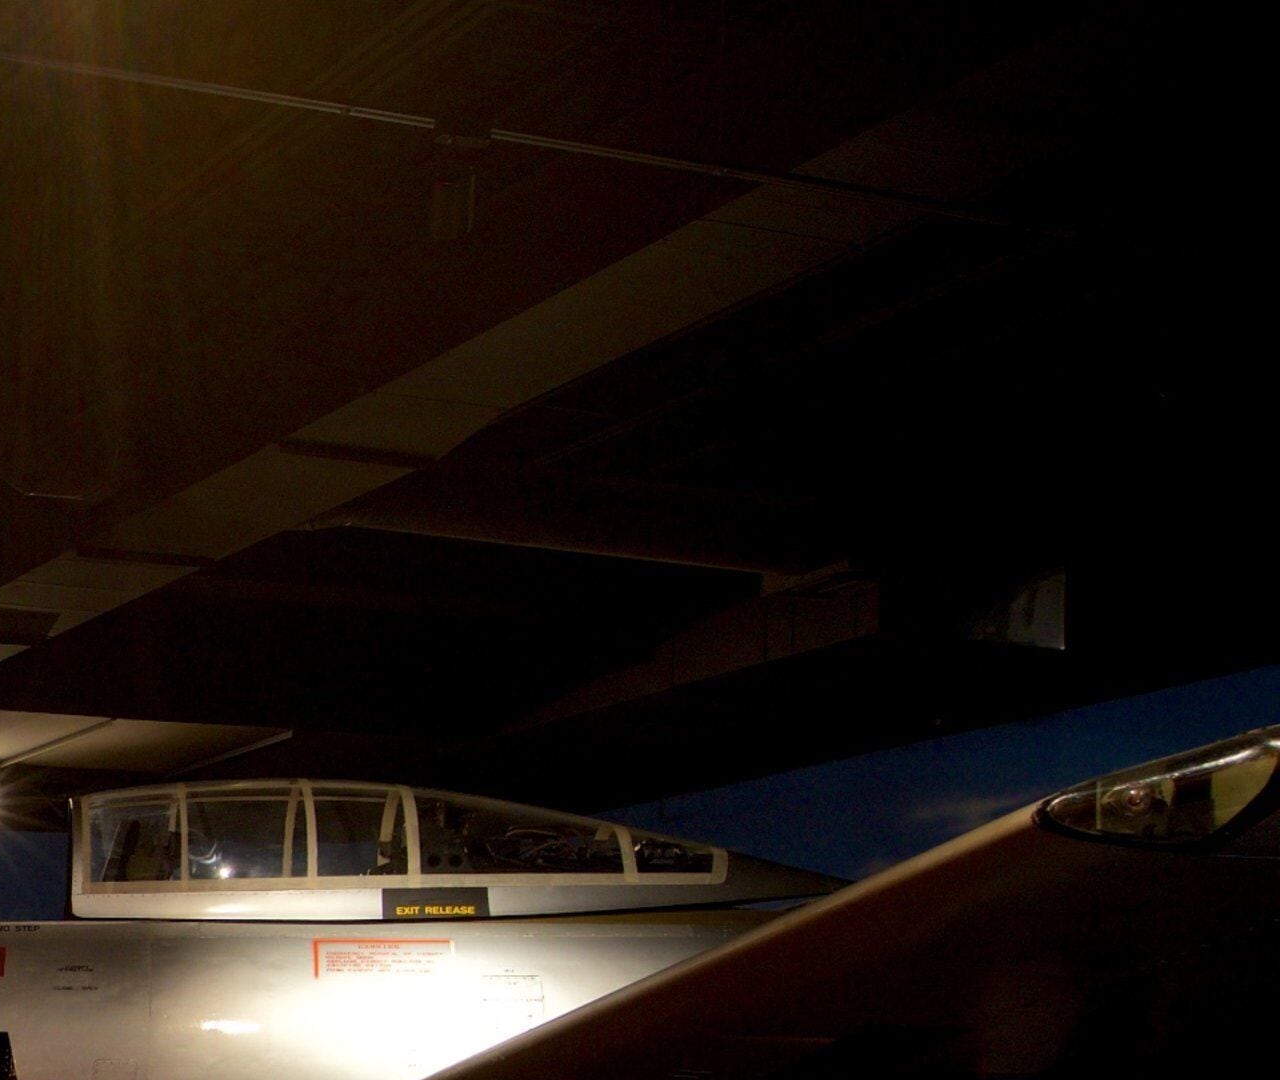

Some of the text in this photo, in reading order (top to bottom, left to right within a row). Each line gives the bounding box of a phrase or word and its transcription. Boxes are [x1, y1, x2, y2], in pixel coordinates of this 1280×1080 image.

[396, 906, 475, 916] EXIT RELEASE
[16, 924, 40, 932] STEP
